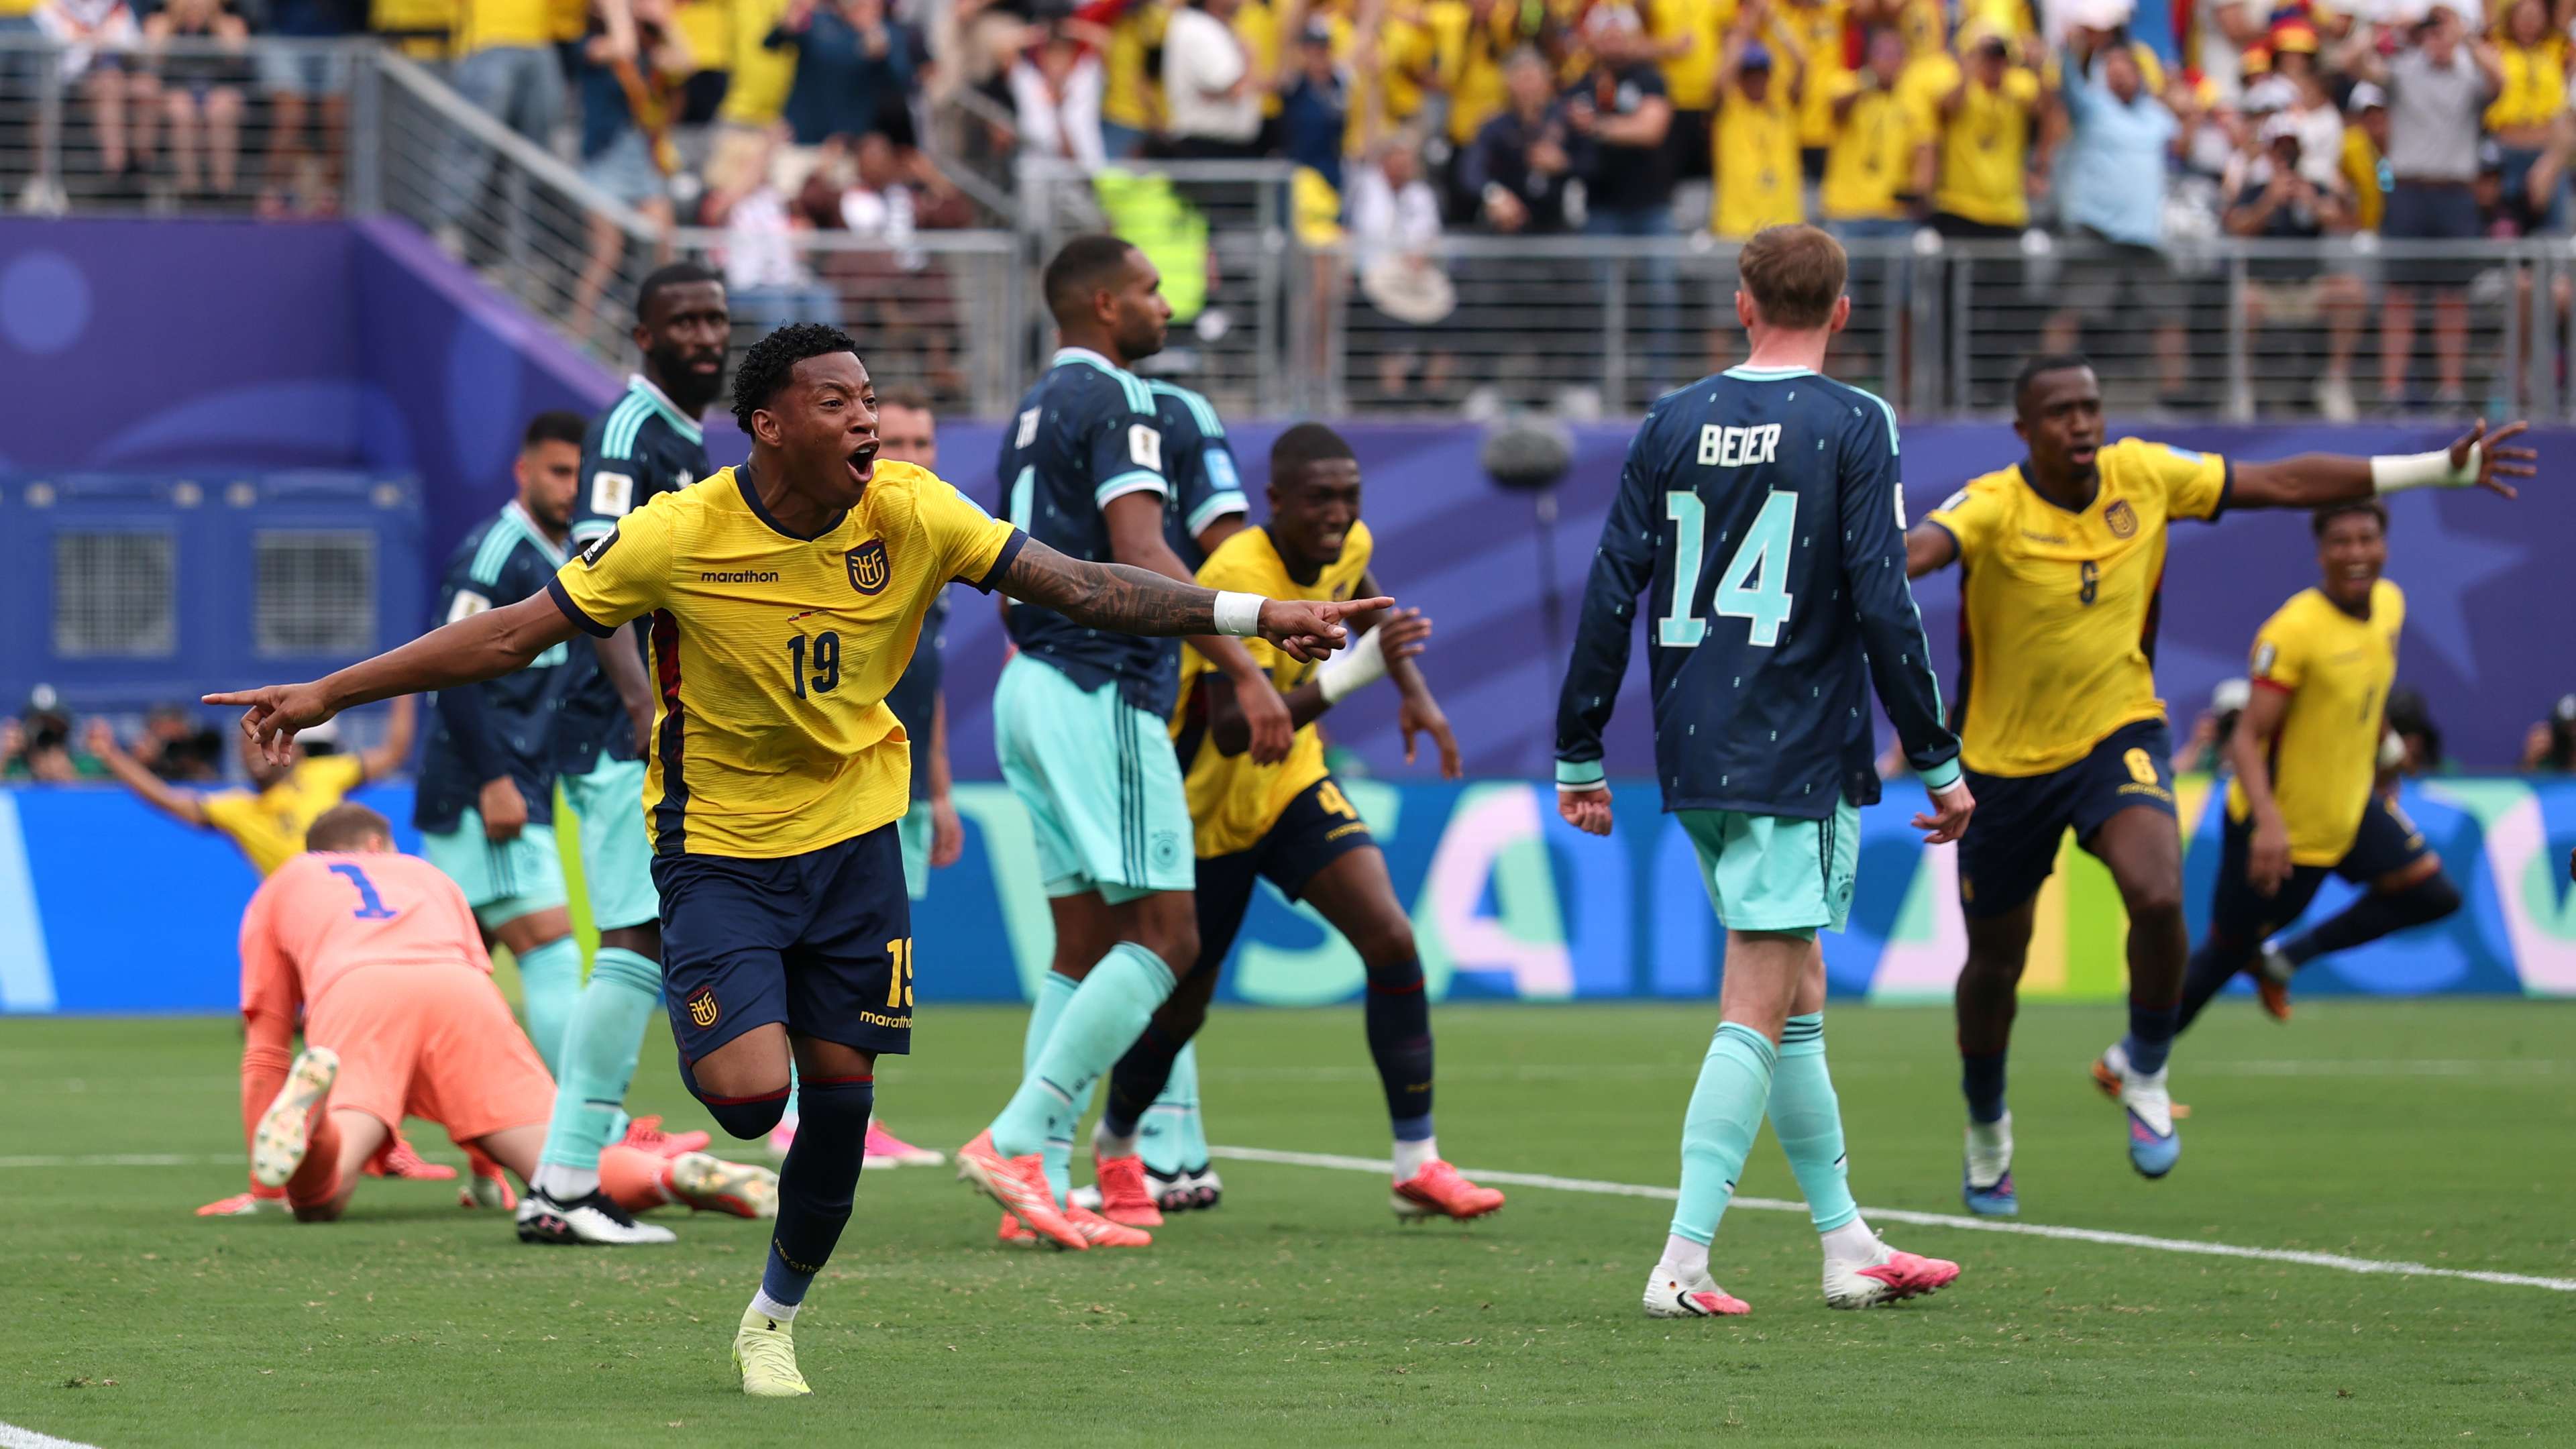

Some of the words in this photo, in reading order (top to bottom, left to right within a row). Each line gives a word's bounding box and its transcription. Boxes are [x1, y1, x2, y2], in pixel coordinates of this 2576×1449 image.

[1697, 423, 1782, 468] BEIER
[701, 570, 779, 583] marathon
[1658, 490, 1799, 647] 14
[787, 631, 841, 700] 19
[1316, 780, 1358, 820] 4
[328, 863, 397, 919] 1
